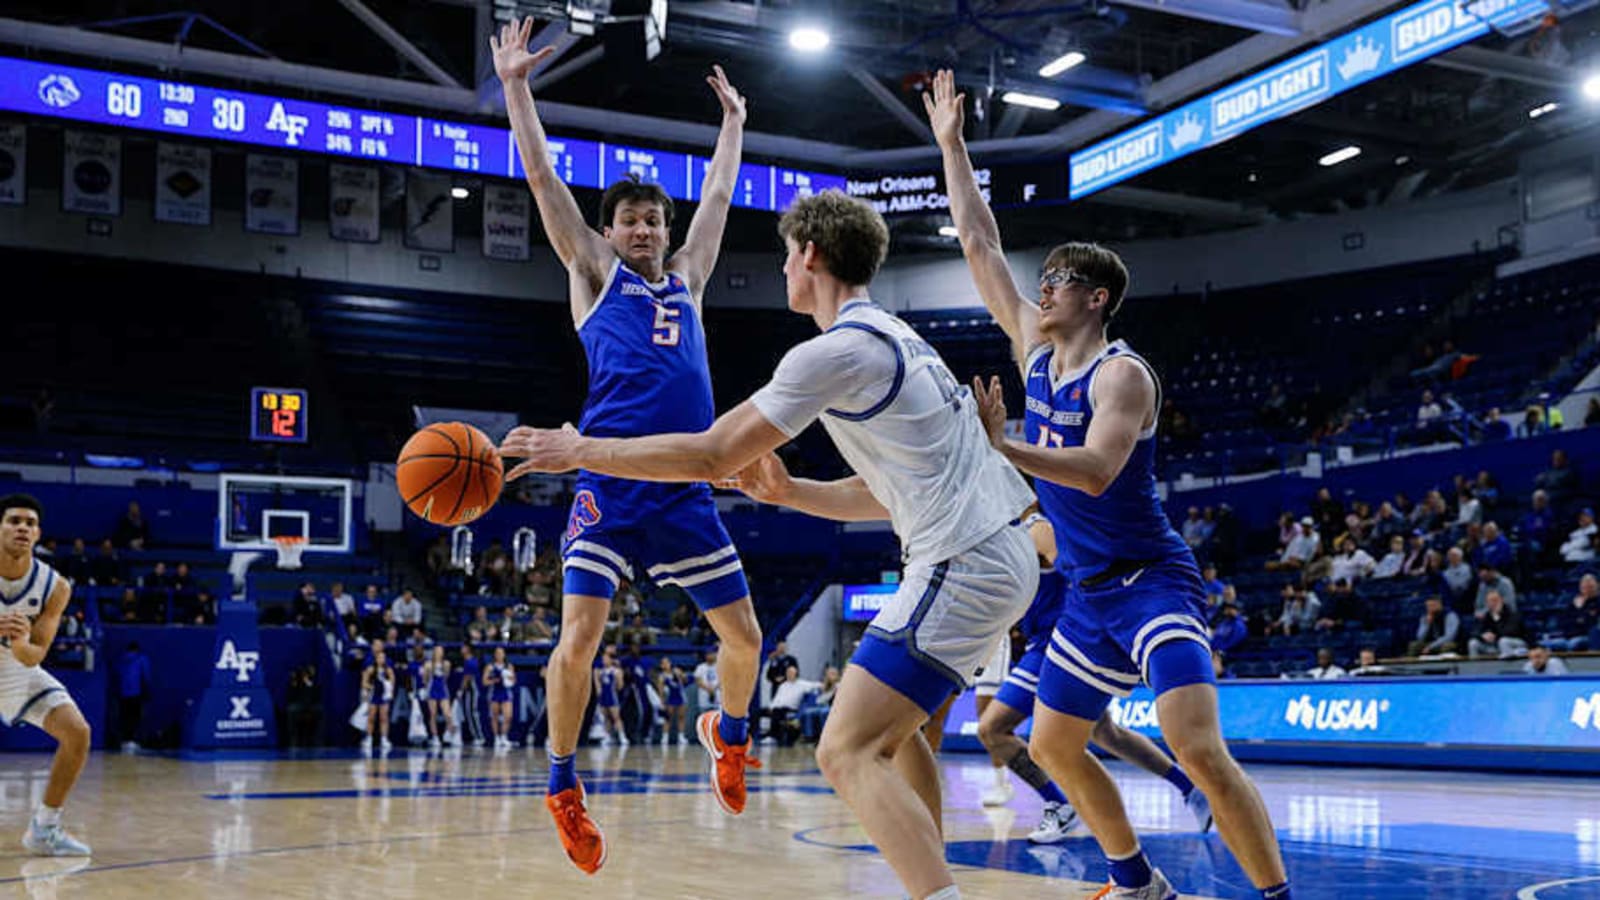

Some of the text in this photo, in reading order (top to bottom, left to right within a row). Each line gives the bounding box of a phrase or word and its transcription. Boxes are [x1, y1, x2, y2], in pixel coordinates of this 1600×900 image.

[1398, 4, 1451, 50] BUD
[107, 82, 141, 117] 60
[1216, 60, 1322, 126] BUD LIGHT
[212, 98, 245, 132] 30
[265, 102, 309, 145] AF
[1072, 131, 1159, 186] BUD LIGHT
[847, 180, 879, 196] New
[880, 175, 936, 193] Orleans
[1023, 184, 1037, 202] F
[652, 303, 680, 346] 5
[271, 409, 296, 437] 12
[215, 639, 259, 682] AF
[229, 696, 251, 719] X
[1122, 699, 1158, 728] USA
[1315, 698, 1378, 730] USAA
